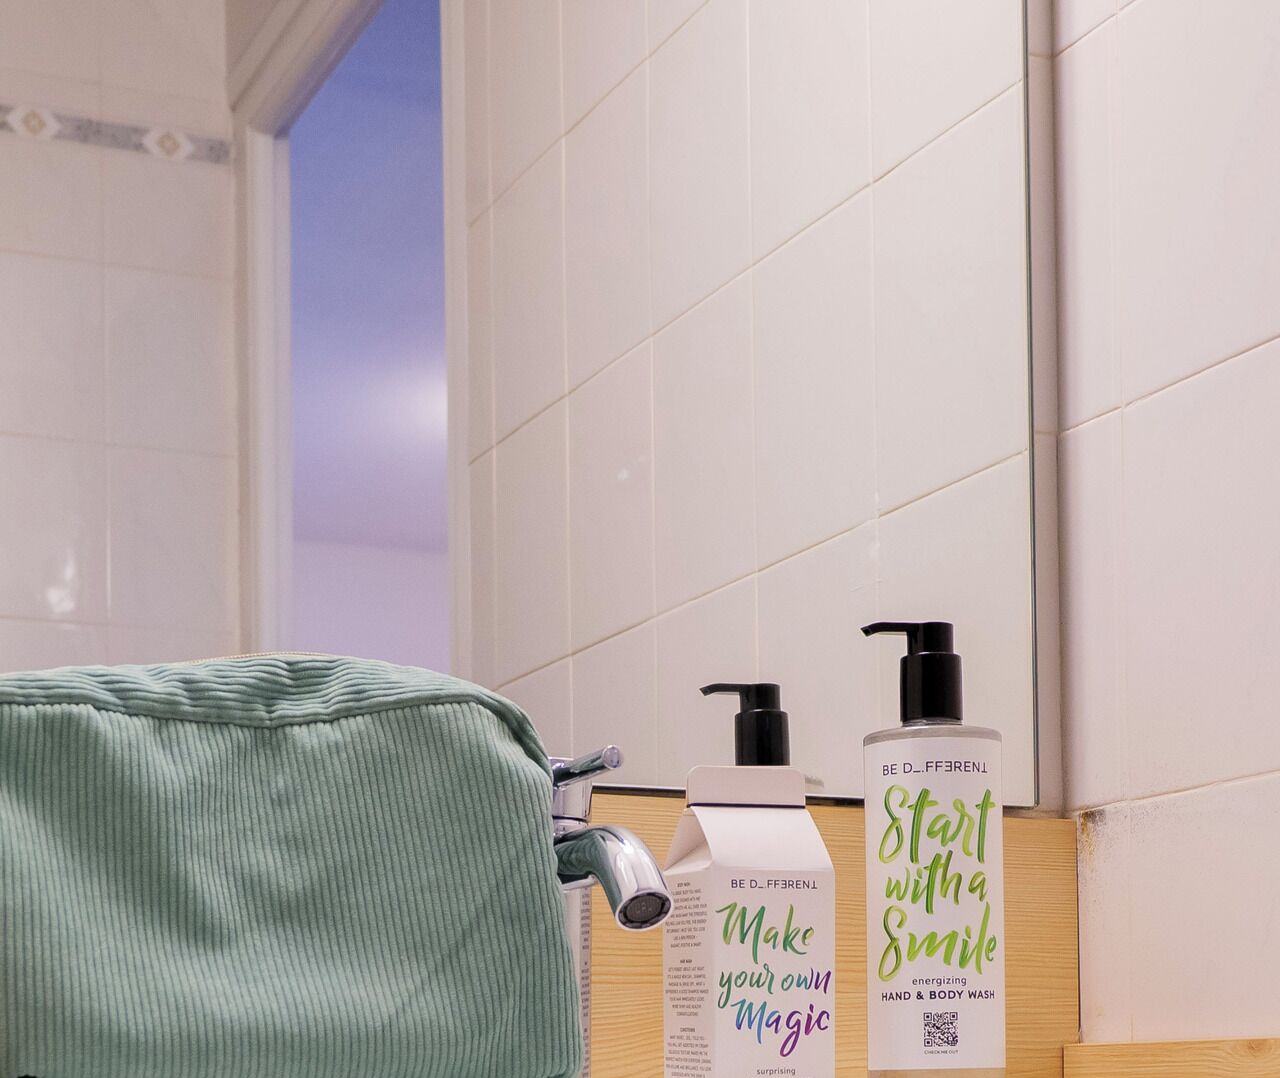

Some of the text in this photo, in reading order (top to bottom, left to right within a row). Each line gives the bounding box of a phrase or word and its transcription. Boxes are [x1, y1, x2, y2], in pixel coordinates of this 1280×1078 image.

[883, 764, 897, 775] BE
[878, 784, 996, 864] Start
[731, 879, 745, 889] BE
[885, 850, 988, 914] with a
[715, 901, 814, 965] Make
[878, 902, 997, 982] Smile
[717, 963, 775, 1009] your
[781, 967, 831, 995] own
[882, 990, 995, 1001] HAND & BODY WASH
[912, 976, 967, 986] energizing
[730, 998, 830, 1057] Magic
[757, 1067, 796, 1076] surprising
